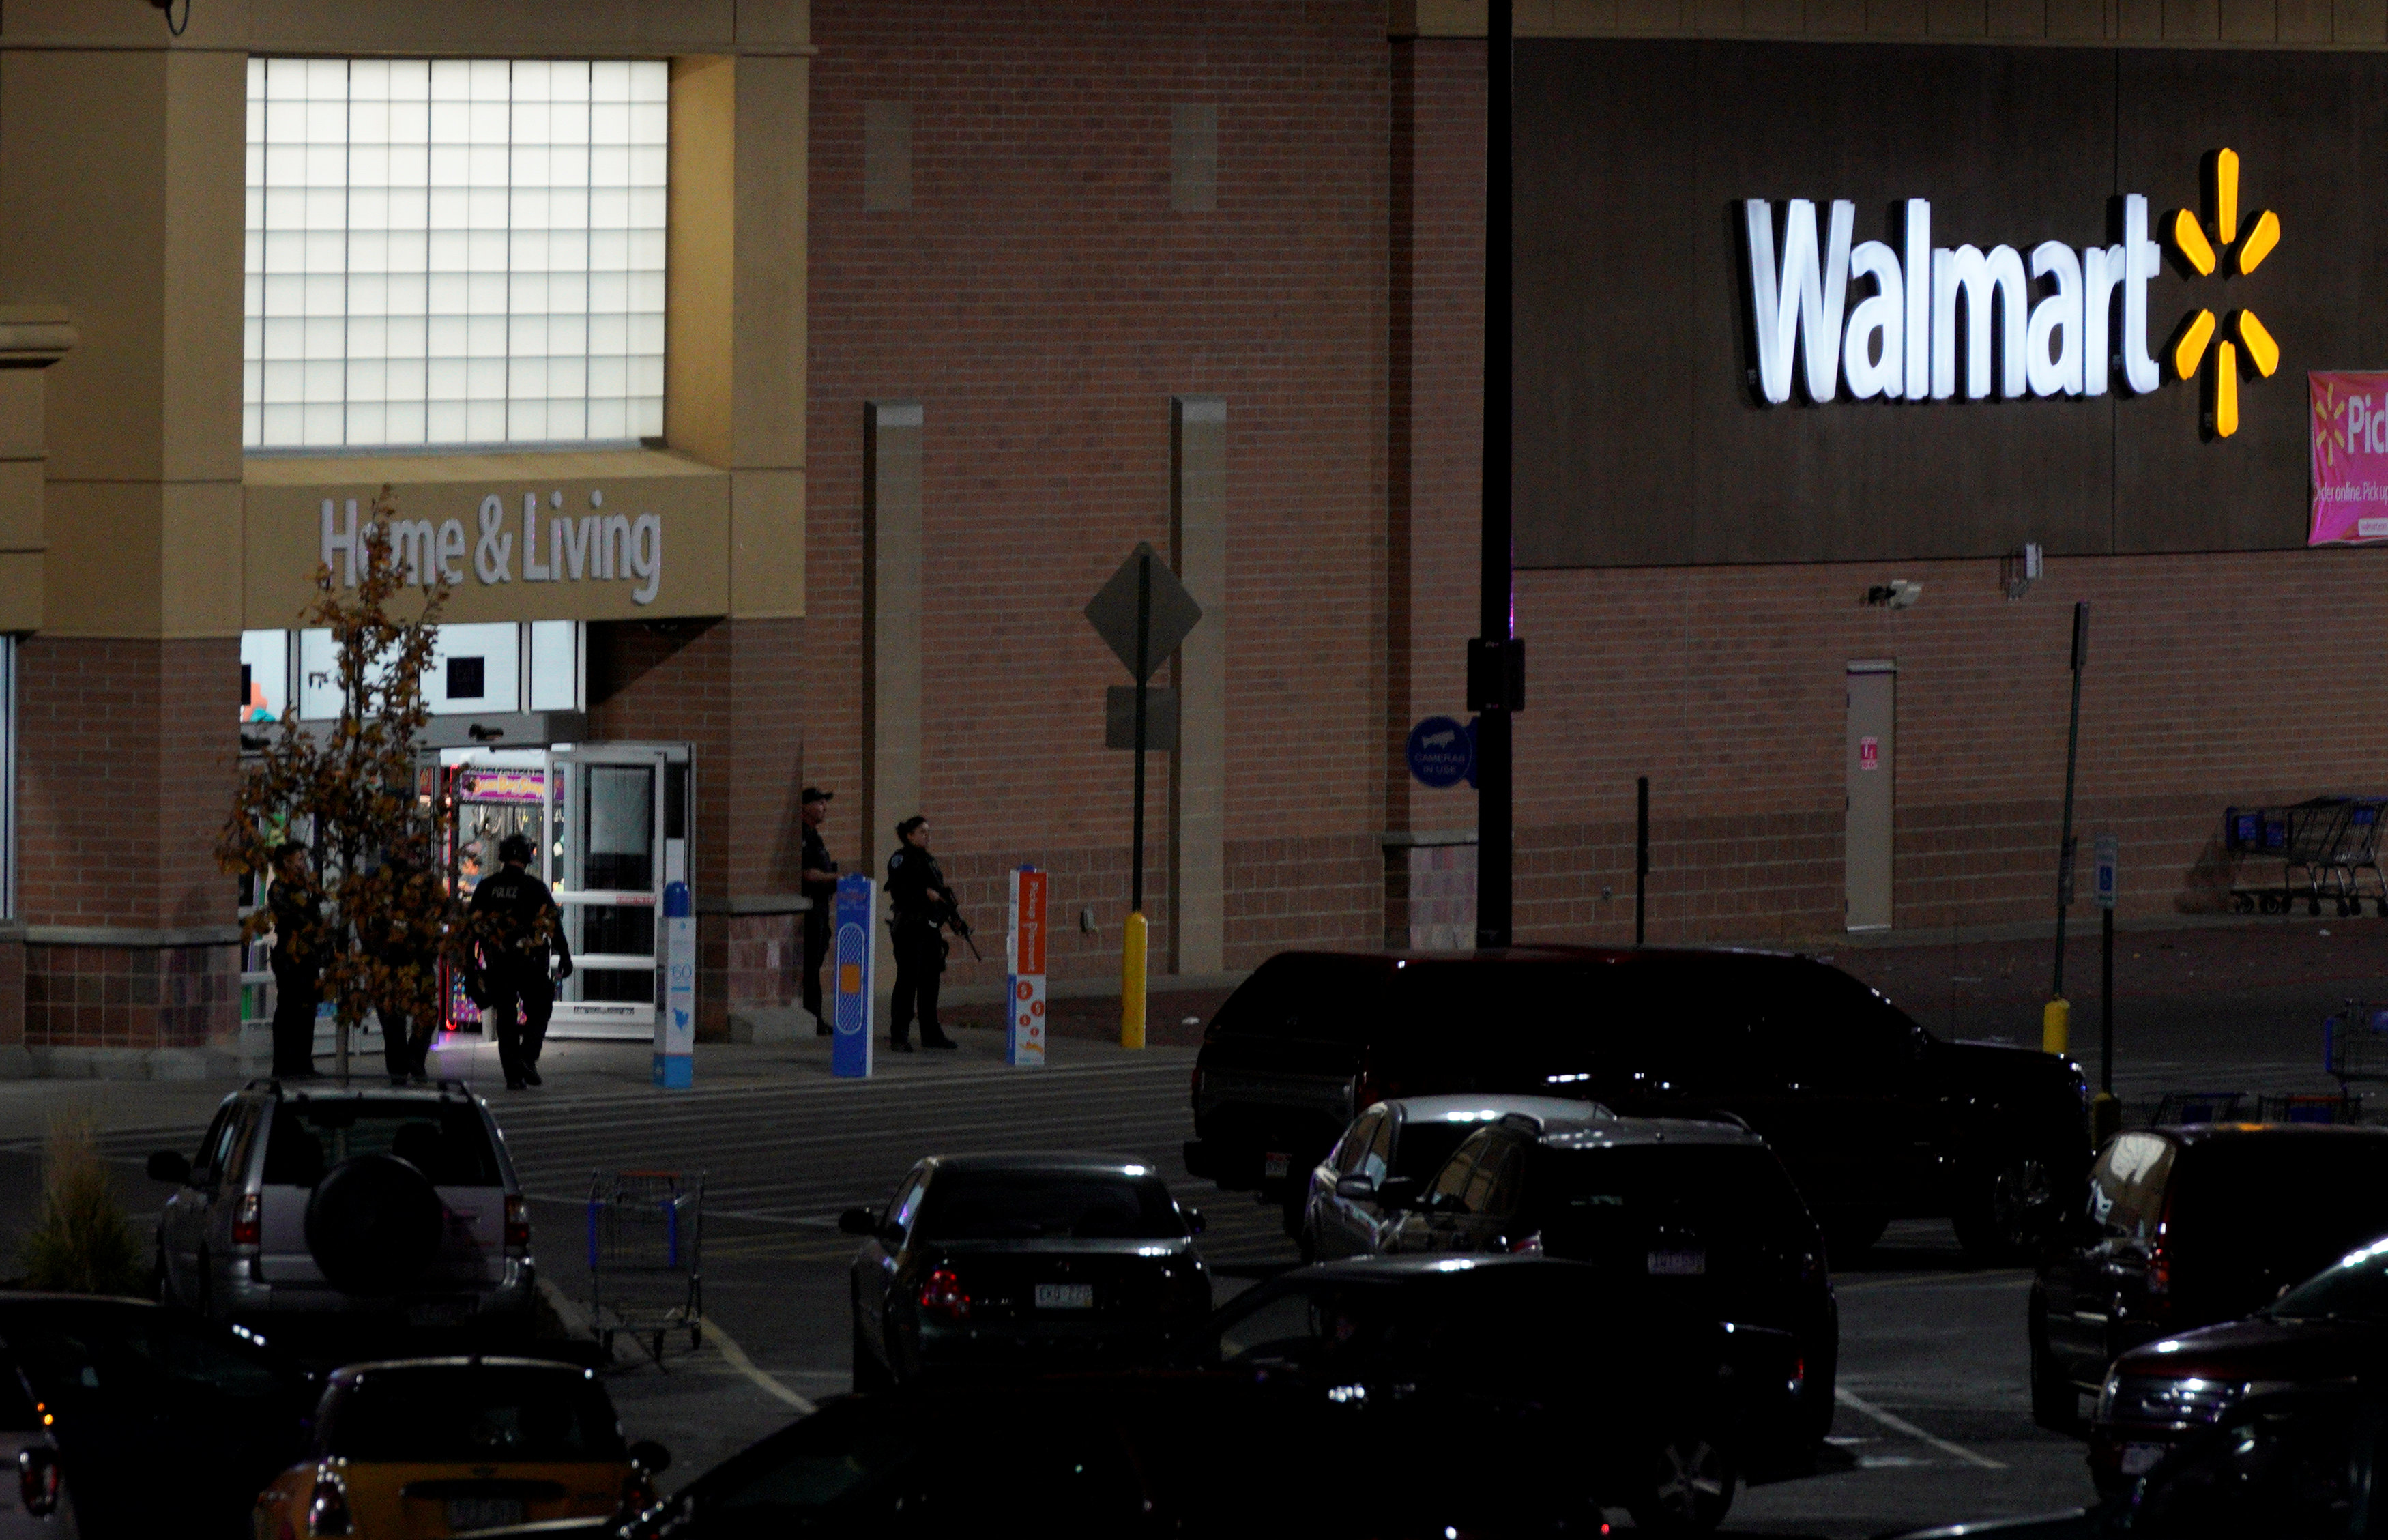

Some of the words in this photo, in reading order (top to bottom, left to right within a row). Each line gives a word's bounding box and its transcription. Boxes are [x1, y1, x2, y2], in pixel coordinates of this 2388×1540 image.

[1744, 194, 2161, 404] Walmart
[2335, 481, 2362, 502] online.
[2363, 481, 2379, 502] Pick
[320, 498, 465, 589] Home
[474, 493, 513, 586] &
[522, 489, 661, 605] Living
[491, 885, 519, 899] POLICE
